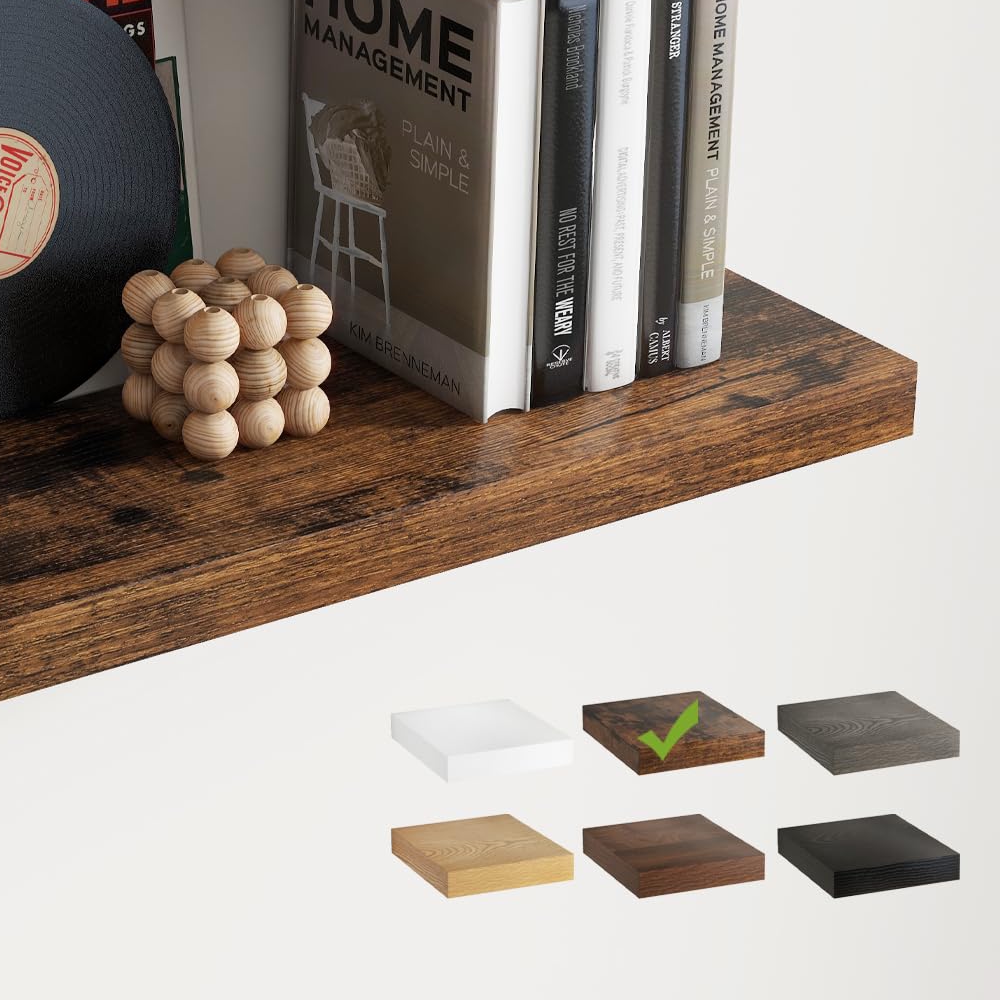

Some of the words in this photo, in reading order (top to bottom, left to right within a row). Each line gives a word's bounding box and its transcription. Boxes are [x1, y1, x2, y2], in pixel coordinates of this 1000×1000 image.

[567, 4, 587, 44] Nicholas
[668, 1, 683, 60] STRANGER
[304, 13, 472, 113] MANAGEMENT
[707, 42, 725, 160] MANAGEMENT
[402, 119, 453, 161] PLAIN
[458, 148, 470, 170] &
[408, 148, 470, 195] SIMPLE
[704, 167, 719, 211] PLAIN
[559, 207, 578, 224] NO
[703, 214, 717, 224] &
[558, 224, 577, 251] REST
[700, 227, 716, 280] SIMPLE
[557, 252, 576, 276] FOR
[556, 275, 575, 298] THE
[553, 297, 574, 337] WEARY
[655, 316, 669, 326] by
[348, 320, 372, 343] KIM
[375, 335, 461, 396] BRENNEMAN
[647, 332, 660, 365] CAMUS
[661, 330, 671, 361] ALBERT
